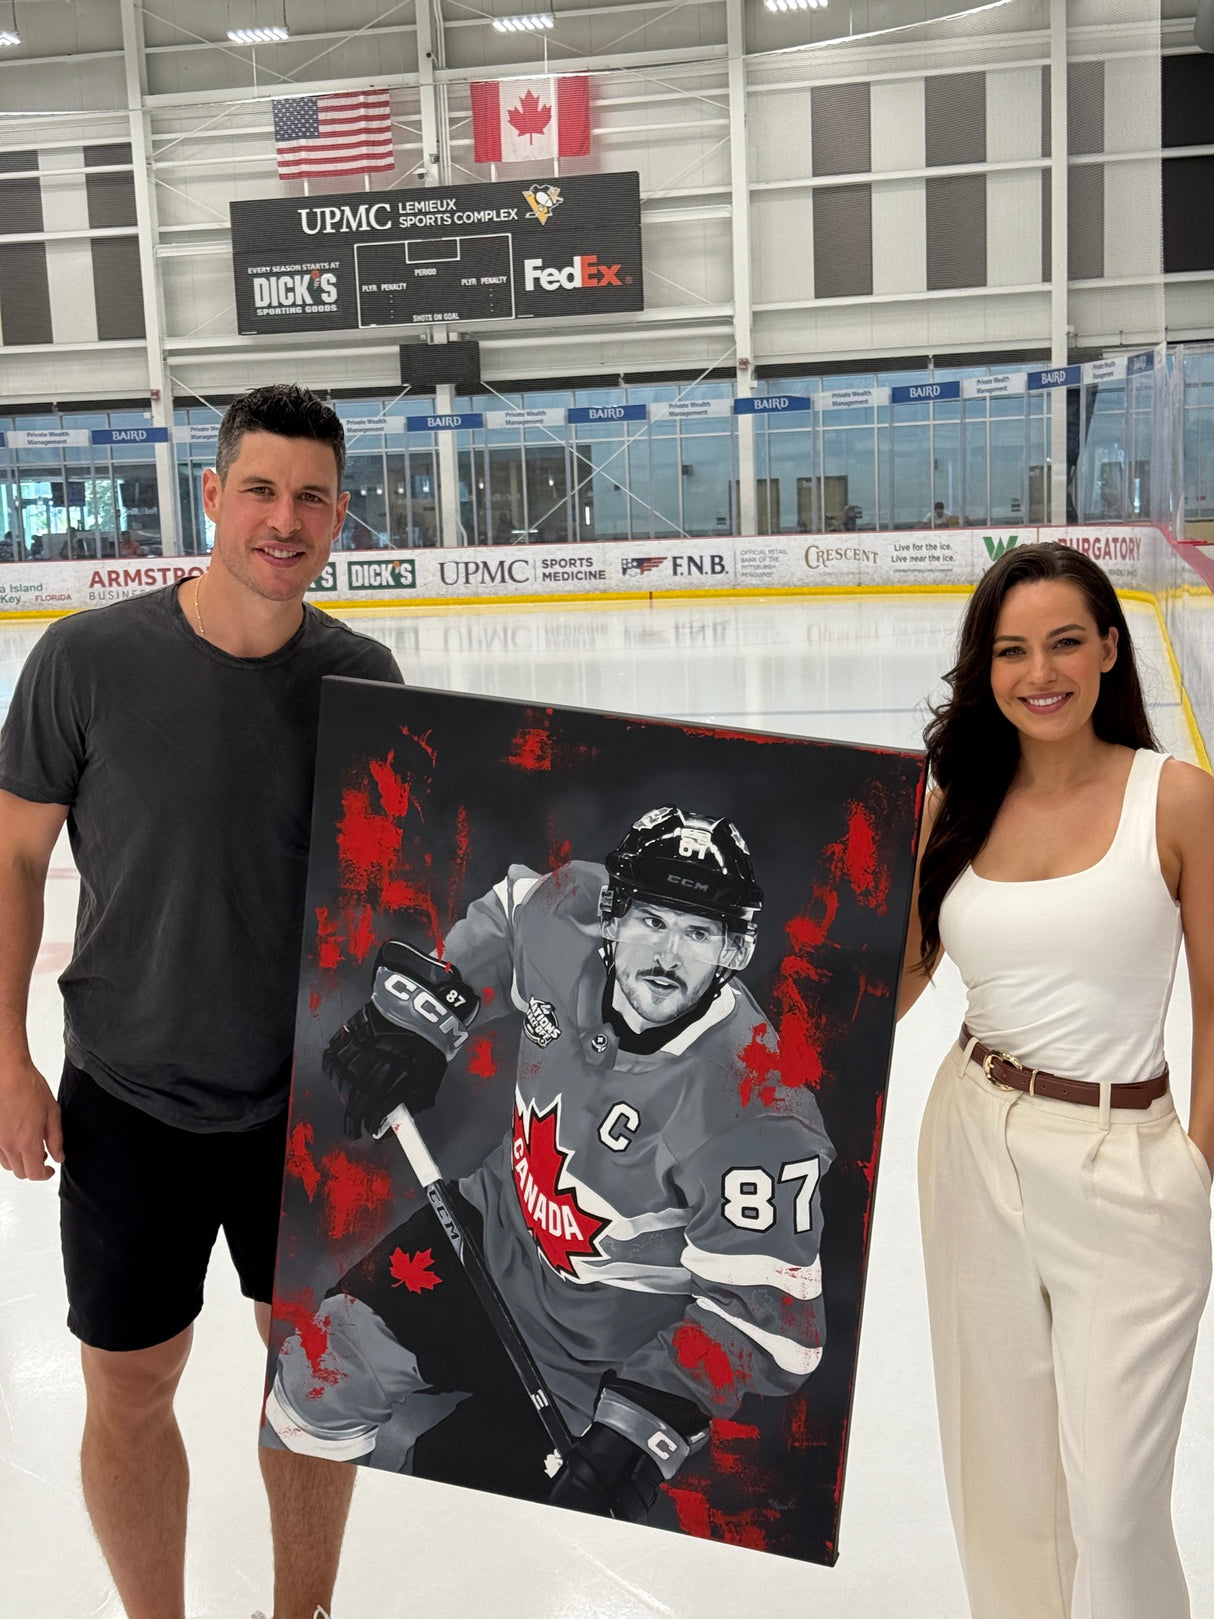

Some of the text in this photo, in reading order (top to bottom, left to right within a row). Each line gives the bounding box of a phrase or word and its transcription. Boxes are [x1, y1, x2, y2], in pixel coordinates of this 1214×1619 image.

[399, 198, 457, 214] LEMIEUX
[297, 203, 392, 235] UPMC
[399, 208, 518, 228] SPORTS COMPLEX
[248, 266, 271, 274] EVERY
[272, 264, 301, 272] SEASON
[302, 262, 329, 270] STARTS
[414, 268, 437, 276] PERIOD
[524, 255, 622, 291] FedEx
[362, 282, 407, 292] PLYR PENALTY
[461, 276, 508, 286] PLYR PENALTY
[253, 270, 338, 307] DICK'S
[256, 304, 338, 316] SPORTING GOODS
[412, 314, 432, 322] SHOTS
[444, 312, 460, 320] GOAL
[1042, 370, 1066, 384] BAIRD
[910, 385, 940, 398] BAIRD
[754, 398, 788, 410] BAIRD
[589, 408, 624, 420] BAIRD
[427, 416, 462, 428] BAIRD
[112, 430, 147, 442] BAIRD
[347, 426, 384, 434] Management
[894, 542, 952, 552] Live for the ice.
[542, 558, 593, 568] SPORTS
[928, 554, 940, 562] the
[942, 554, 956, 562] ice.
[672, 554, 728, 576] F.N.B.
[89, 566, 210, 588] ARMSTRO
[351, 560, 412, 586] DICK'S
[438, 560, 530, 586] UPMC
[542, 570, 606, 582] MEDICINE
[10, 583, 43, 592] Island
[0, 594, 72, 604] Key FLORIDA
[89, 590, 154, 600] BUSINE
[666, 874, 709, 892] CCM
[446, 990, 466, 1008] 87
[384, 974, 468, 1048] CCM
[599, 1102, 640, 1151] C
[514, 1138, 584, 1240] CANADA
[722, 1156, 820, 1233] 87
[429, 1190, 460, 1240] CCM
[648, 1431, 678, 1460] C
